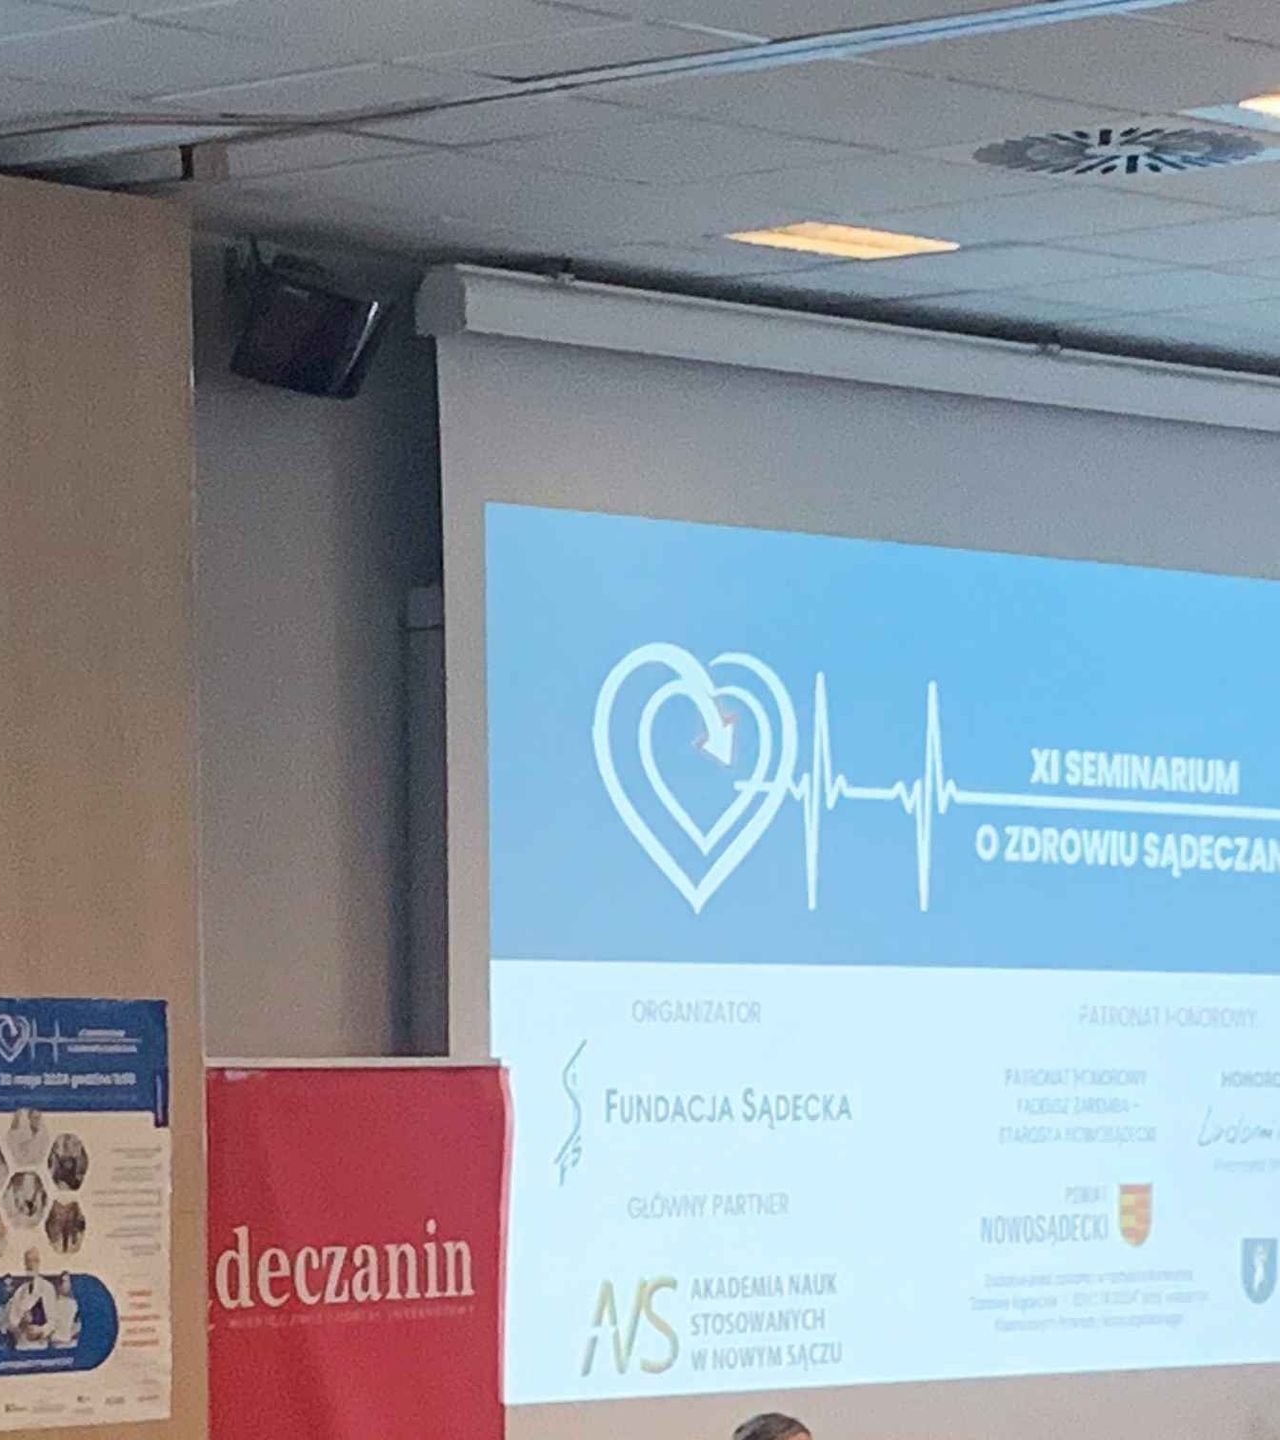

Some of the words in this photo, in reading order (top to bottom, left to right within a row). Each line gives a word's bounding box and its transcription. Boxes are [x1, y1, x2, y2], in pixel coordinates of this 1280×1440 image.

[1030, 748, 1061, 784] XI
[1065, 750, 1240, 795] SEMINARIUM
[975, 824, 999, 861] O
[1004, 825, 1139, 867] ZDROWIU
[631, 999, 762, 1024] ORGANIZATOR
[605, 1088, 735, 1124] FUNDACJA
[742, 1087, 853, 1129] SĄDECKA
[627, 1191, 707, 1220] GŁÓWNY
[712, 1192, 790, 1217] PARTNER
[980, 1213, 1109, 1247] NOWOSĄDECKI
[209, 1218, 476, 1311] deczanin
[691, 1274, 785, 1300] AKADEMIA
[788, 1272, 838, 1297] NAUK
[691, 1308, 826, 1337] STOSOWANYCH
[691, 1350, 708, 1371] W
[712, 1346, 783, 1371] NOWYM
[787, 1341, 843, 1373] SĄCZU
